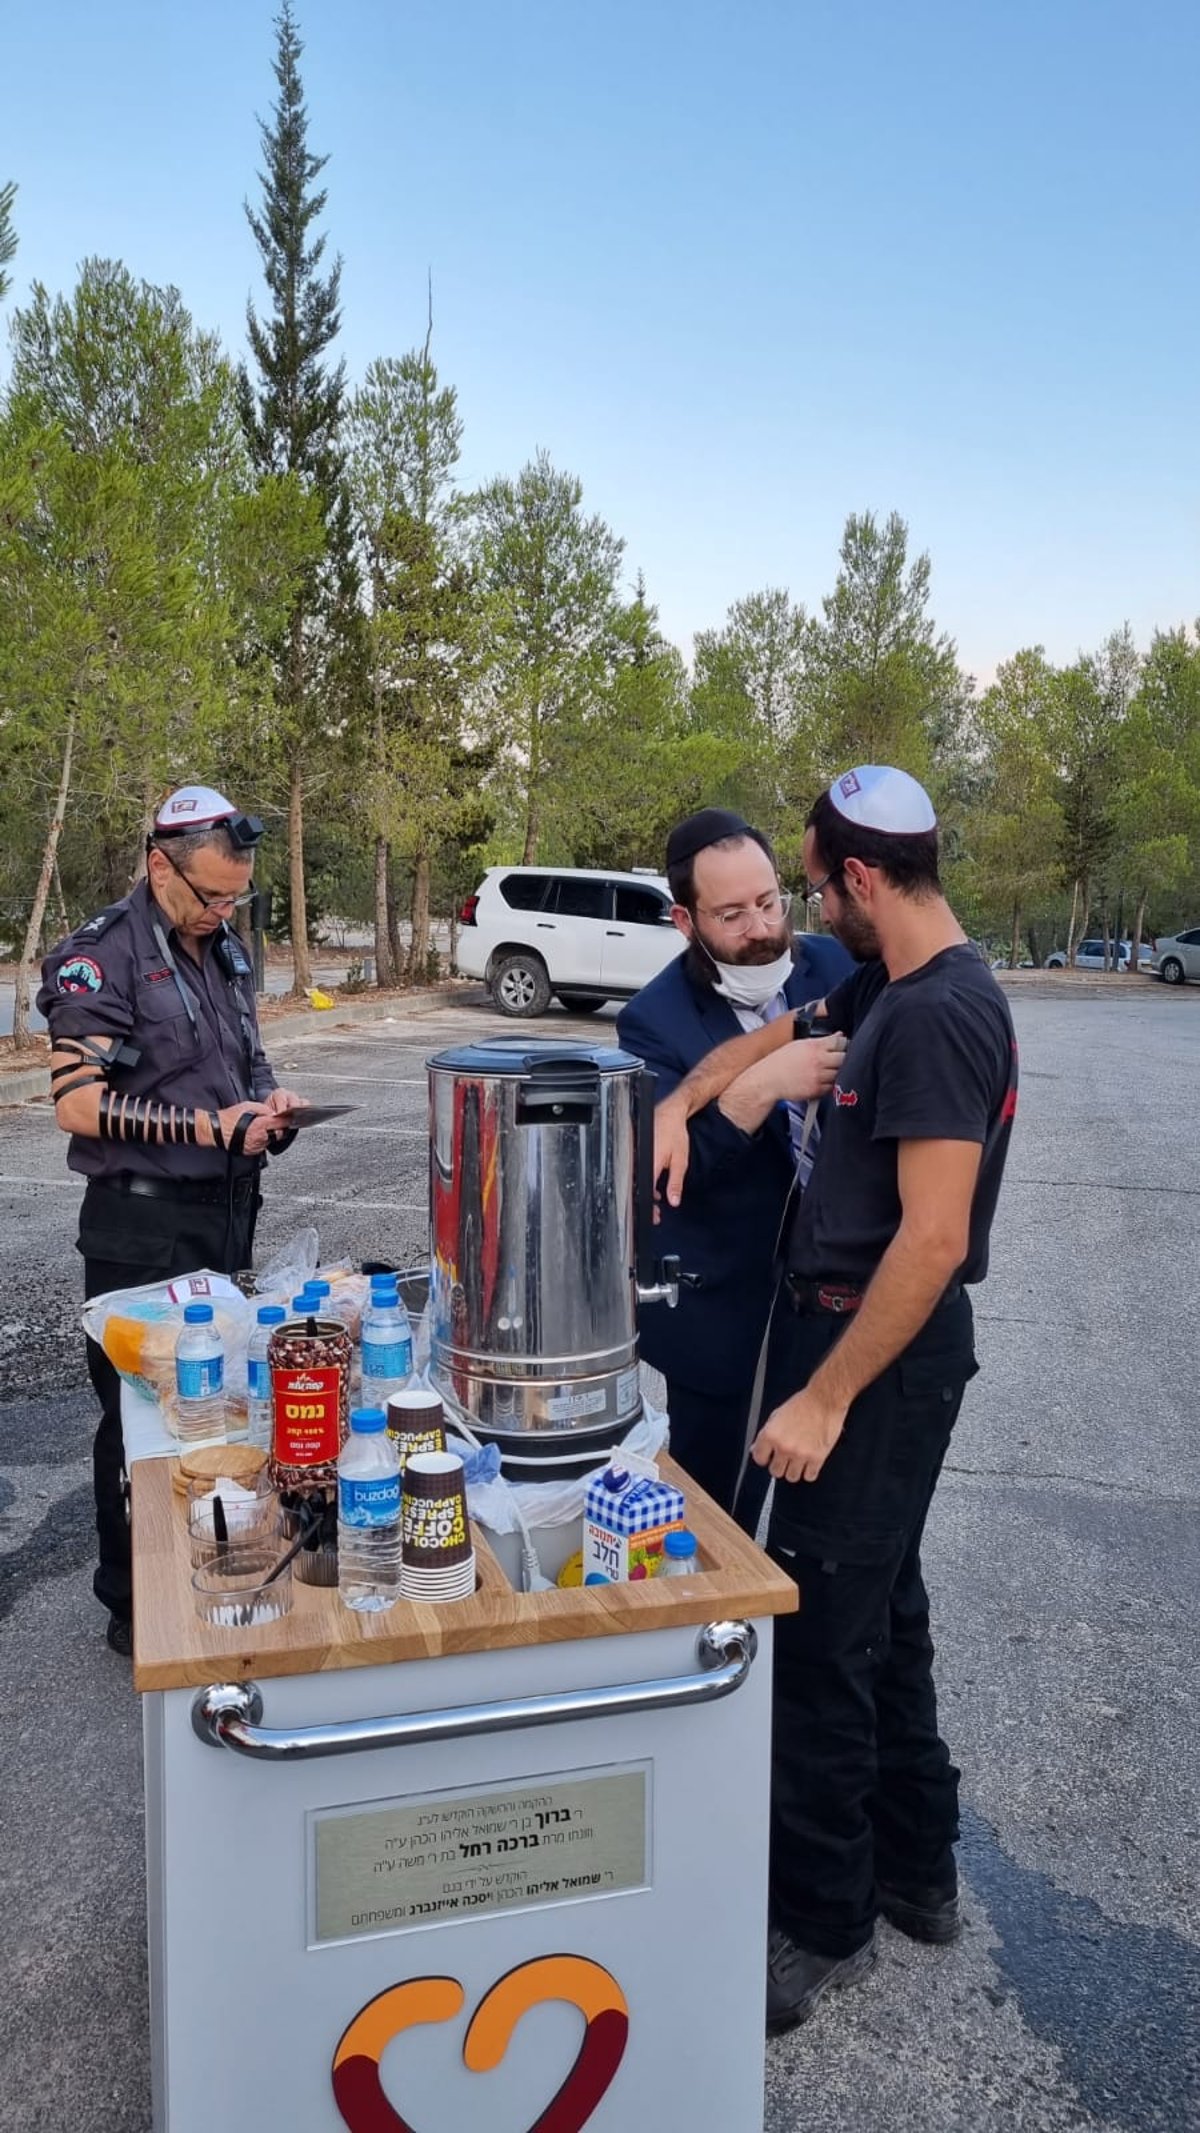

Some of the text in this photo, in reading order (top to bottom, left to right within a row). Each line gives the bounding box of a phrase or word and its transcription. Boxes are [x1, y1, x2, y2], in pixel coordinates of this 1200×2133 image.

[286, 1404, 325, 1419] נמס
[592, 1540, 619, 1569] חלב
[521, 1817, 532, 1832] בן
[535, 1807, 571, 1829] ברוך
[440, 1827, 469, 1842] אליהו
[472, 1820, 507, 1836] שמואל
[410, 1832, 437, 1849] הכהן
[497, 1834, 540, 1853] ברכה
[541, 1830, 565, 1845] מרת
[440, 1848, 456, 1862] בת
[459, 1841, 492, 1858] רחל
[398, 1854, 425, 1869] משה
[442, 1881, 463, 1894] בנם
[479, 1875, 493, 1888] על
[526, 1879, 559, 1896] אליהו
[562, 1873, 601, 1888] שמואל
[408, 1897, 461, 1916] אייזנברג
[351, 1908, 407, 1926] ומשפחתם
